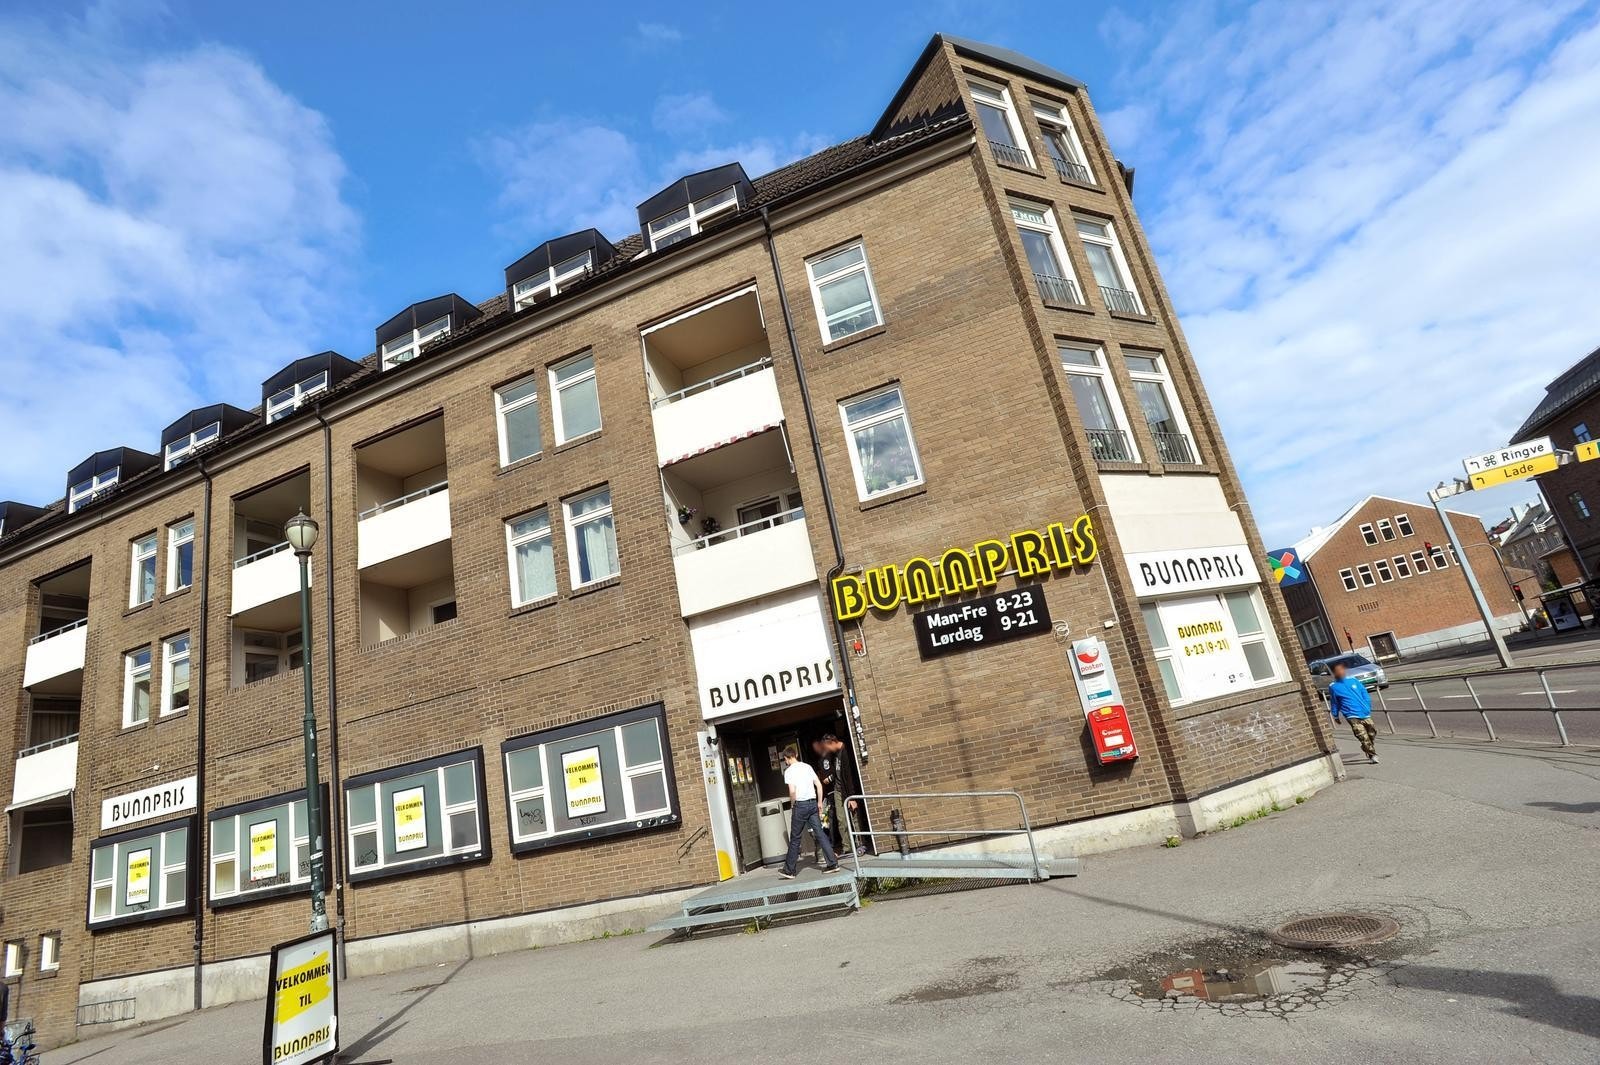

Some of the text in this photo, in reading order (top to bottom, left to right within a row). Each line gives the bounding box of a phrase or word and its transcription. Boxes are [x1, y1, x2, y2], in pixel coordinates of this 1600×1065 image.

[1501, 442, 1545, 463] Ringve
[1504, 463, 1534, 479] Lade
[832, 514, 1098, 621] BUNNPRIS
[1139, 554, 1244, 587] BUNNPRIS
[927, 591, 1034, 629] Man-Fre 8-23
[931, 609, 1039, 648] Lørdag 9-21
[1177, 620, 1223, 639] BUNNPRIS
[1184, 638, 1230, 657] 8-23 (9-21)
[1080, 662, 1104, 673] posten
[709, 658, 835, 708] BUNNPRIS
[565, 762, 599, 774] VELKOMMEN
[578, 776, 587, 784] TIL
[112, 785, 185, 822] BUNNPRIS
[395, 801, 423, 811] VELKOMMEN
[570, 795, 602, 808] BUNNPRIS
[275, 962, 331, 992] VELKOMMEN
[299, 993, 313, 1007] TIL
[273, 1025, 331, 1060] BUNNPRIS
